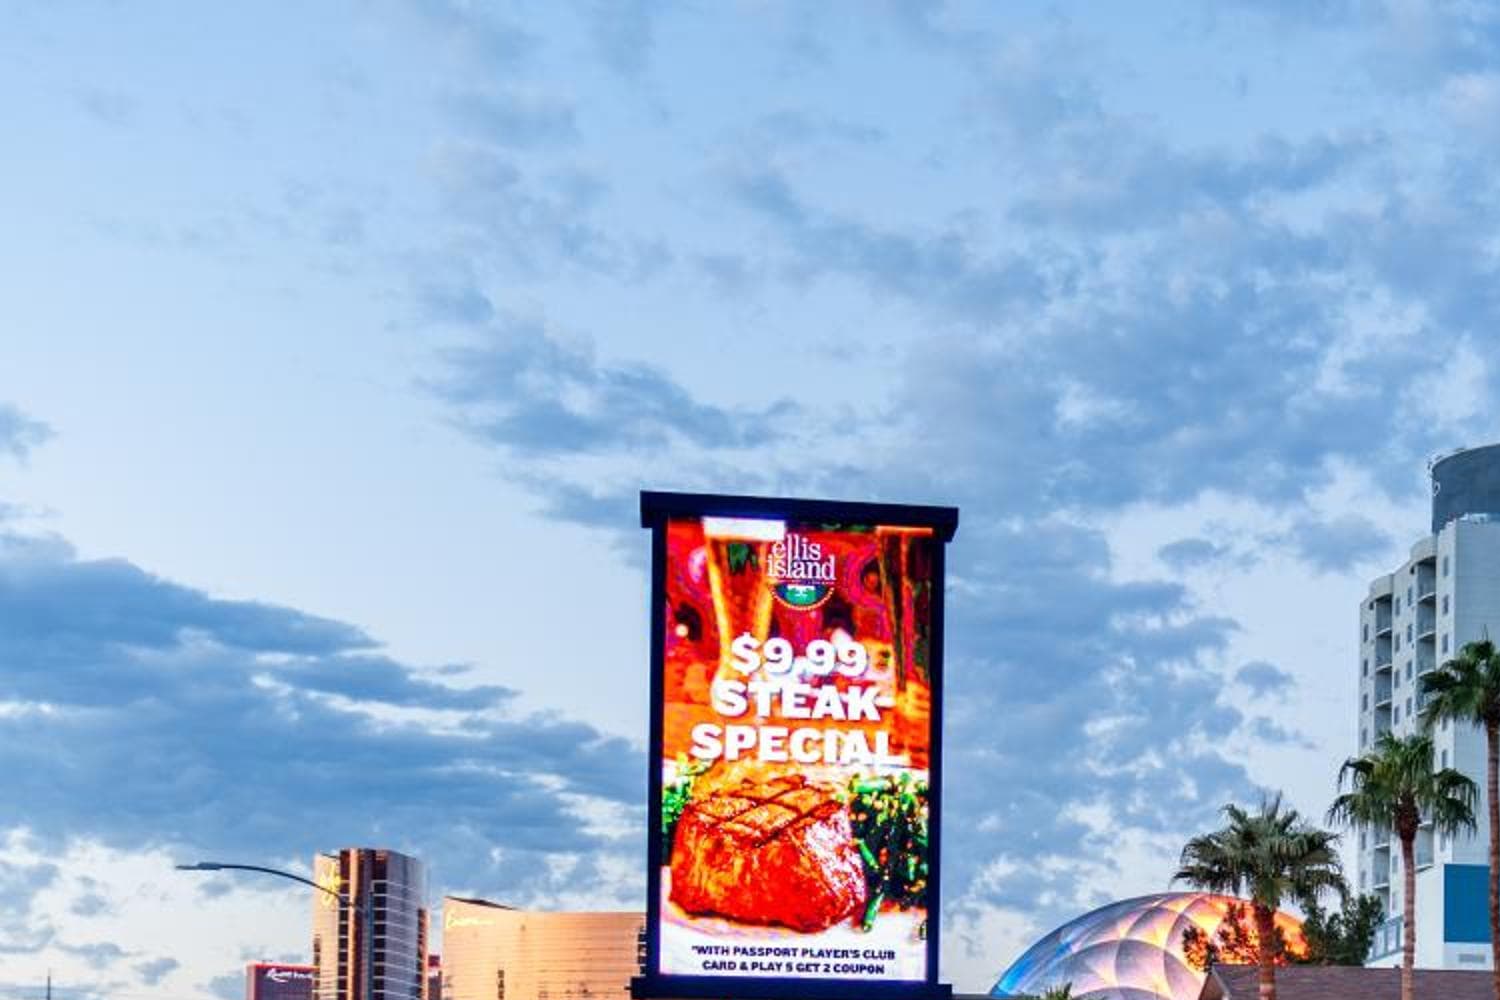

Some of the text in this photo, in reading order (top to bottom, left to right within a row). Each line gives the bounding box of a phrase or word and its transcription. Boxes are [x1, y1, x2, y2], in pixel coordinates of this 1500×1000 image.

[772, 534, 821, 561] ellis
[767, 554, 837, 580] island
[731, 632, 868, 677] $9.99
[713, 680, 881, 721] STEAK
[690, 723, 909, 765] SPECIAL
[733, 946, 798, 957] PASSPORT
[801, 947, 860, 959] PLAYER'S
[863, 949, 895, 960] CLUB
[702, 960, 736, 971] CARD
[740, 961, 748, 971] &
[752, 961, 782, 971] PLAY
[796, 963, 820, 972] GET
[823, 963, 830, 973] 2
[833, 963, 884, 974] COUPON
